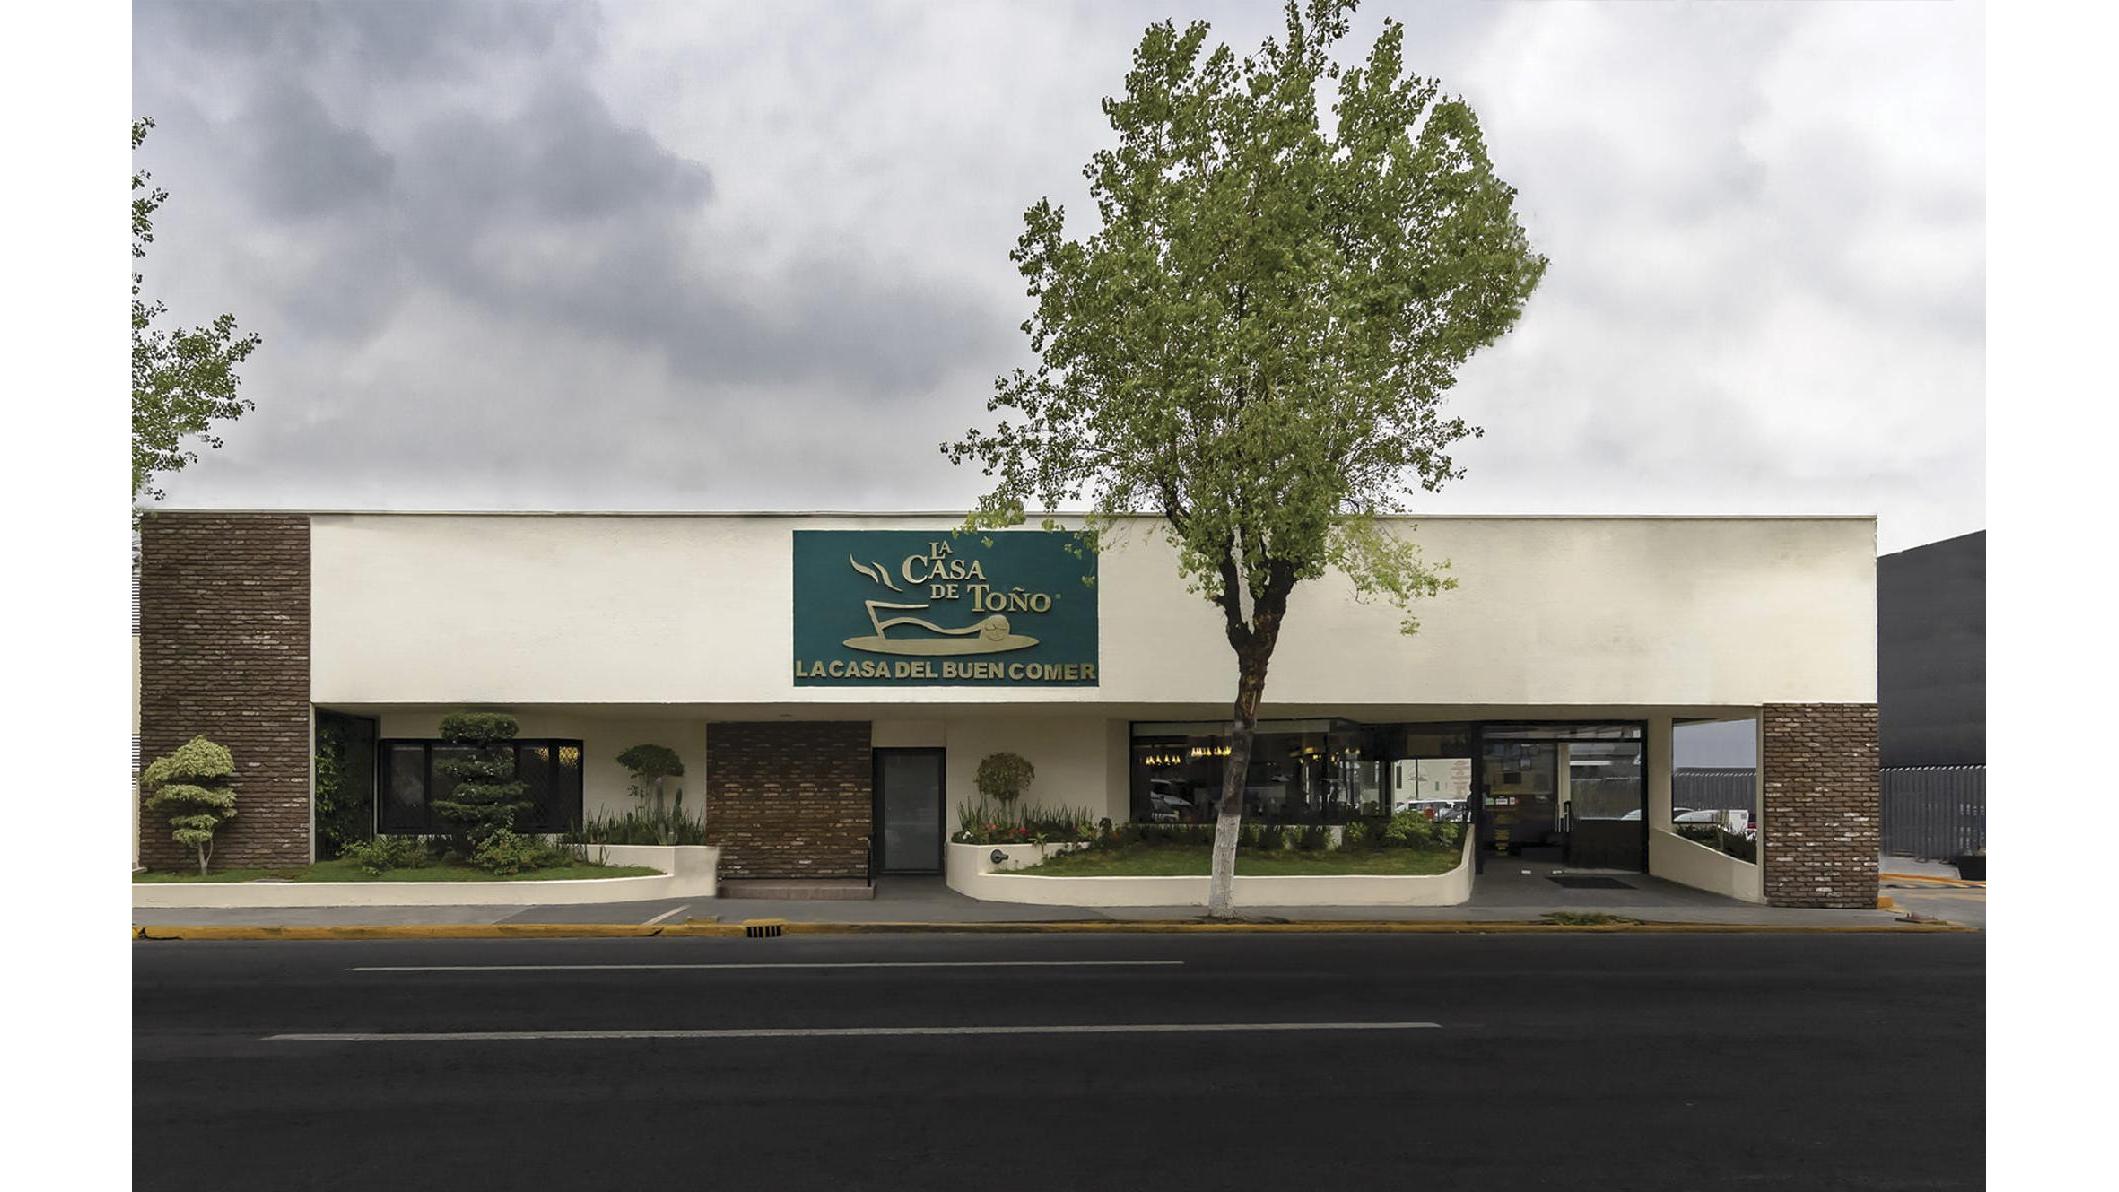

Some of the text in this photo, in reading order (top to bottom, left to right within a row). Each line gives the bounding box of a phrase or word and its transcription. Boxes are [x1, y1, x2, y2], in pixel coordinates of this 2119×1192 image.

[929, 540, 952, 560] LA
[902, 554, 986, 584] CASA
[930, 584, 1051, 612] DE TOÑO
[796, 660, 1096, 680] LA CASA DEL BUEN COMER
